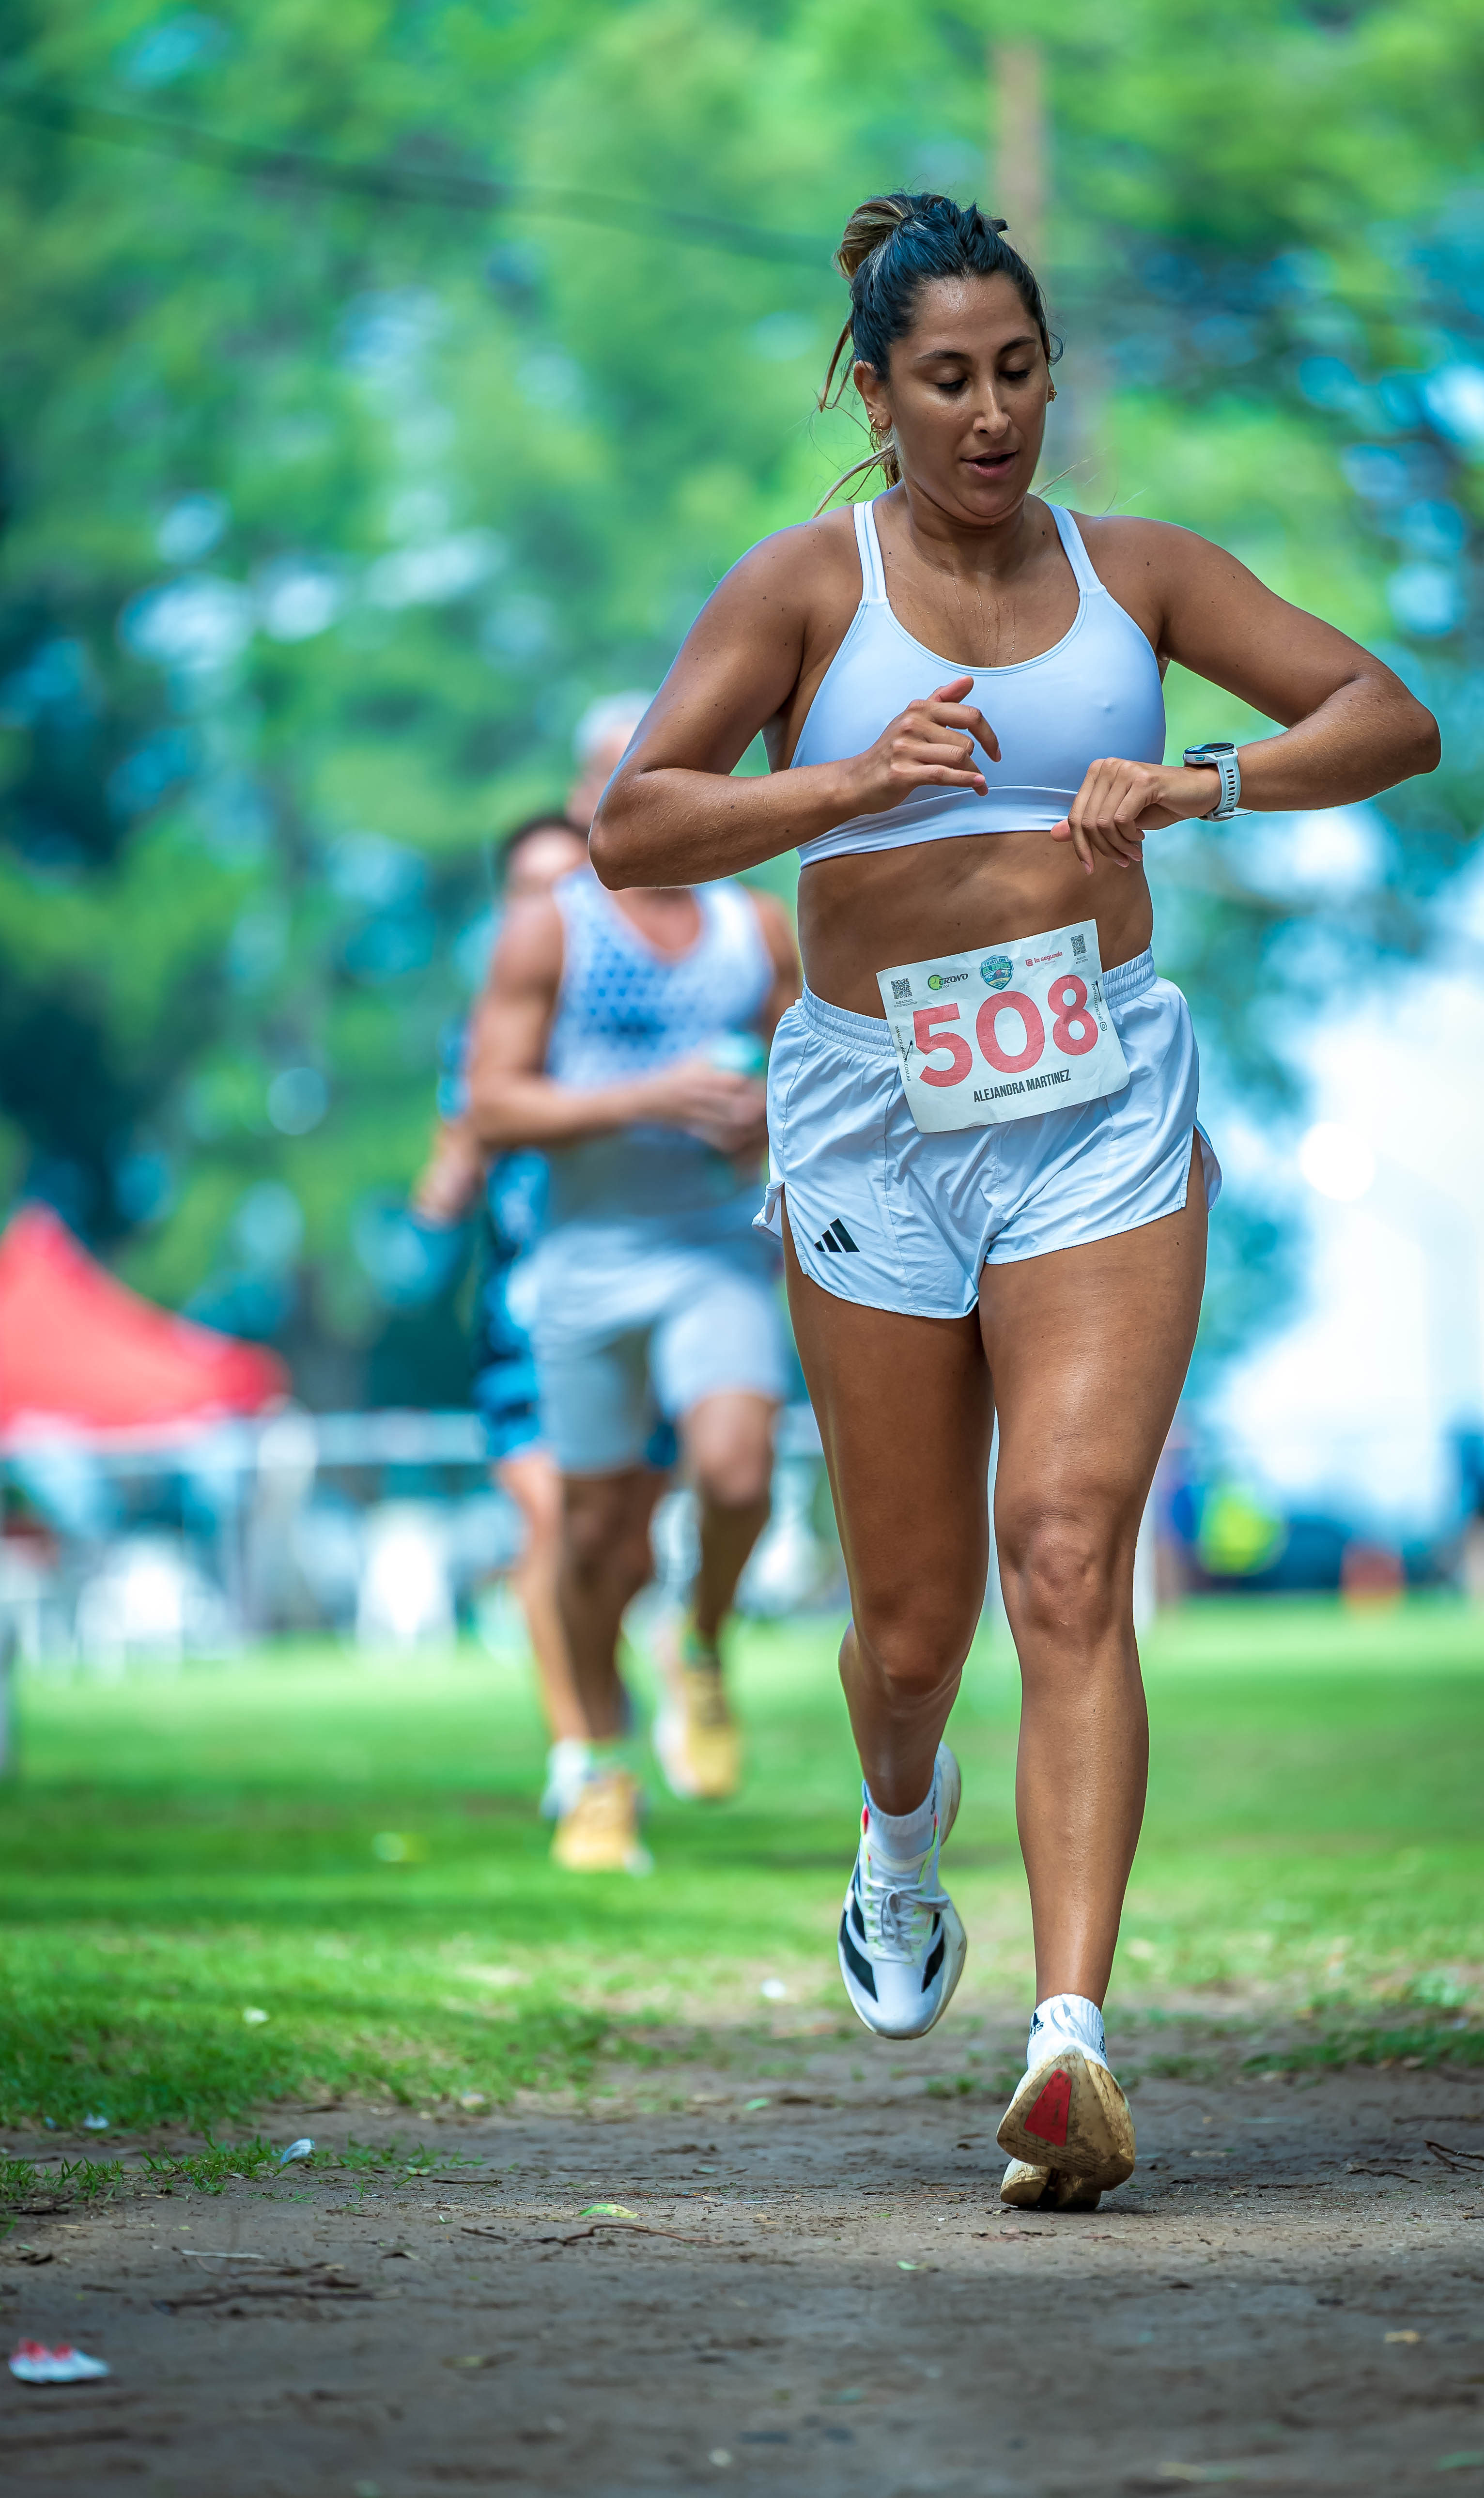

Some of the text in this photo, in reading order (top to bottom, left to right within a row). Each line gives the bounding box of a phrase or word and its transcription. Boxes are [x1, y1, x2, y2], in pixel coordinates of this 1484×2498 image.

[983, 958, 1006, 966] TRIATLON
[1040, 951, 1063, 961] segunda
[939, 973, 968, 985] CRONO
[1091, 982, 1103, 1021] @CRONORAV
[913, 975, 1098, 1087] 508
[895, 1025, 911, 1082] WWW.CRONORV.COM.AR
[974, 1069, 1071, 1102] ALEJANDRA MARTINEZ
